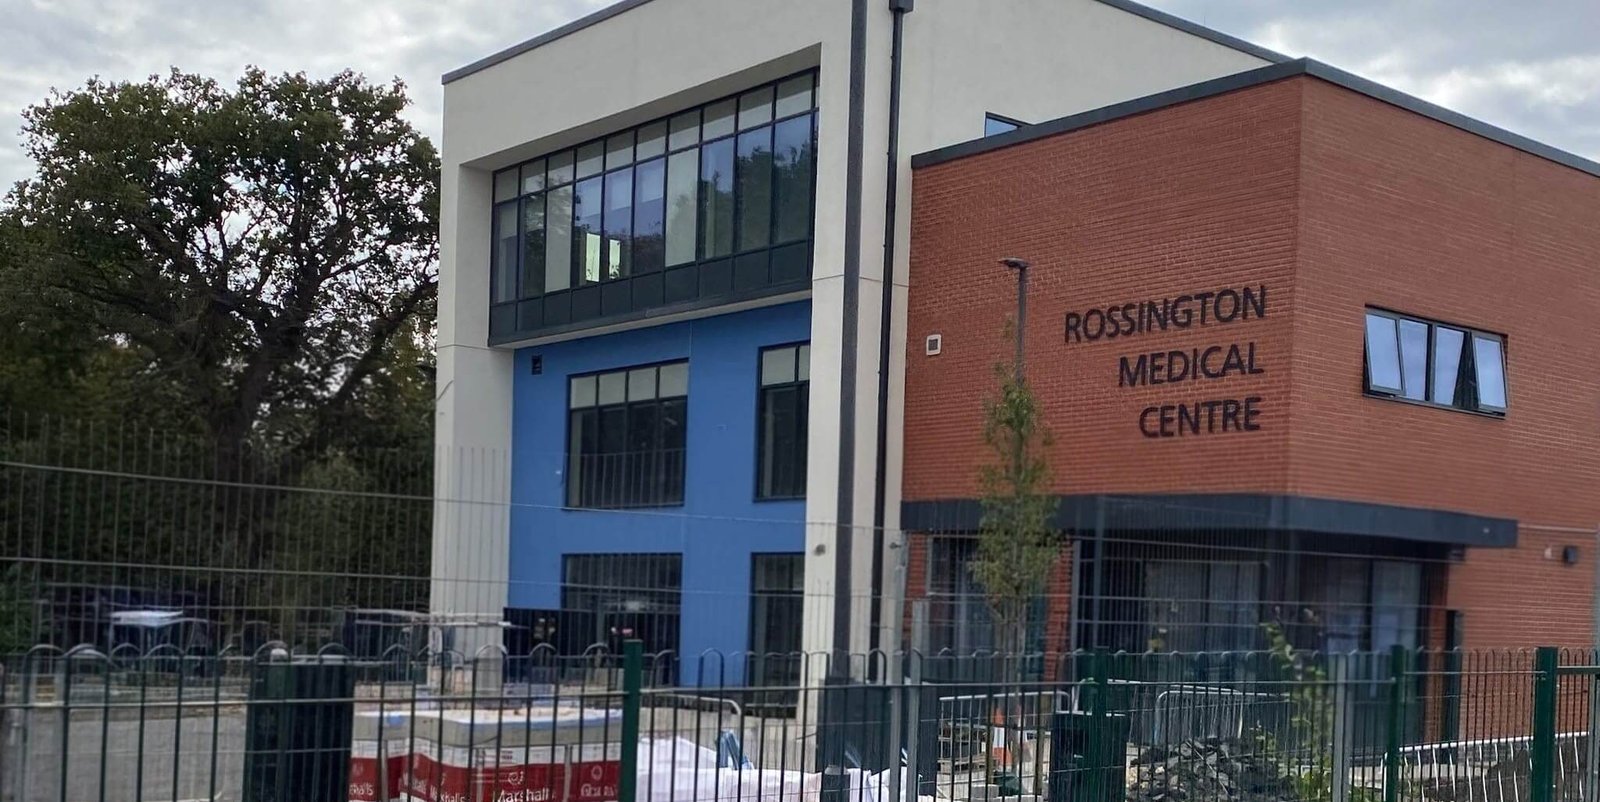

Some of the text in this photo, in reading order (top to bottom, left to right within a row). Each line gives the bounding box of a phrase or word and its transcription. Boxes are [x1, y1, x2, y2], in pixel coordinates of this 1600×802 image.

[1064, 284, 1266, 344] ROSSINGTON
[1118, 342, 1265, 388] MEDICAL
[1138, 397, 1262, 438] CENTRE
